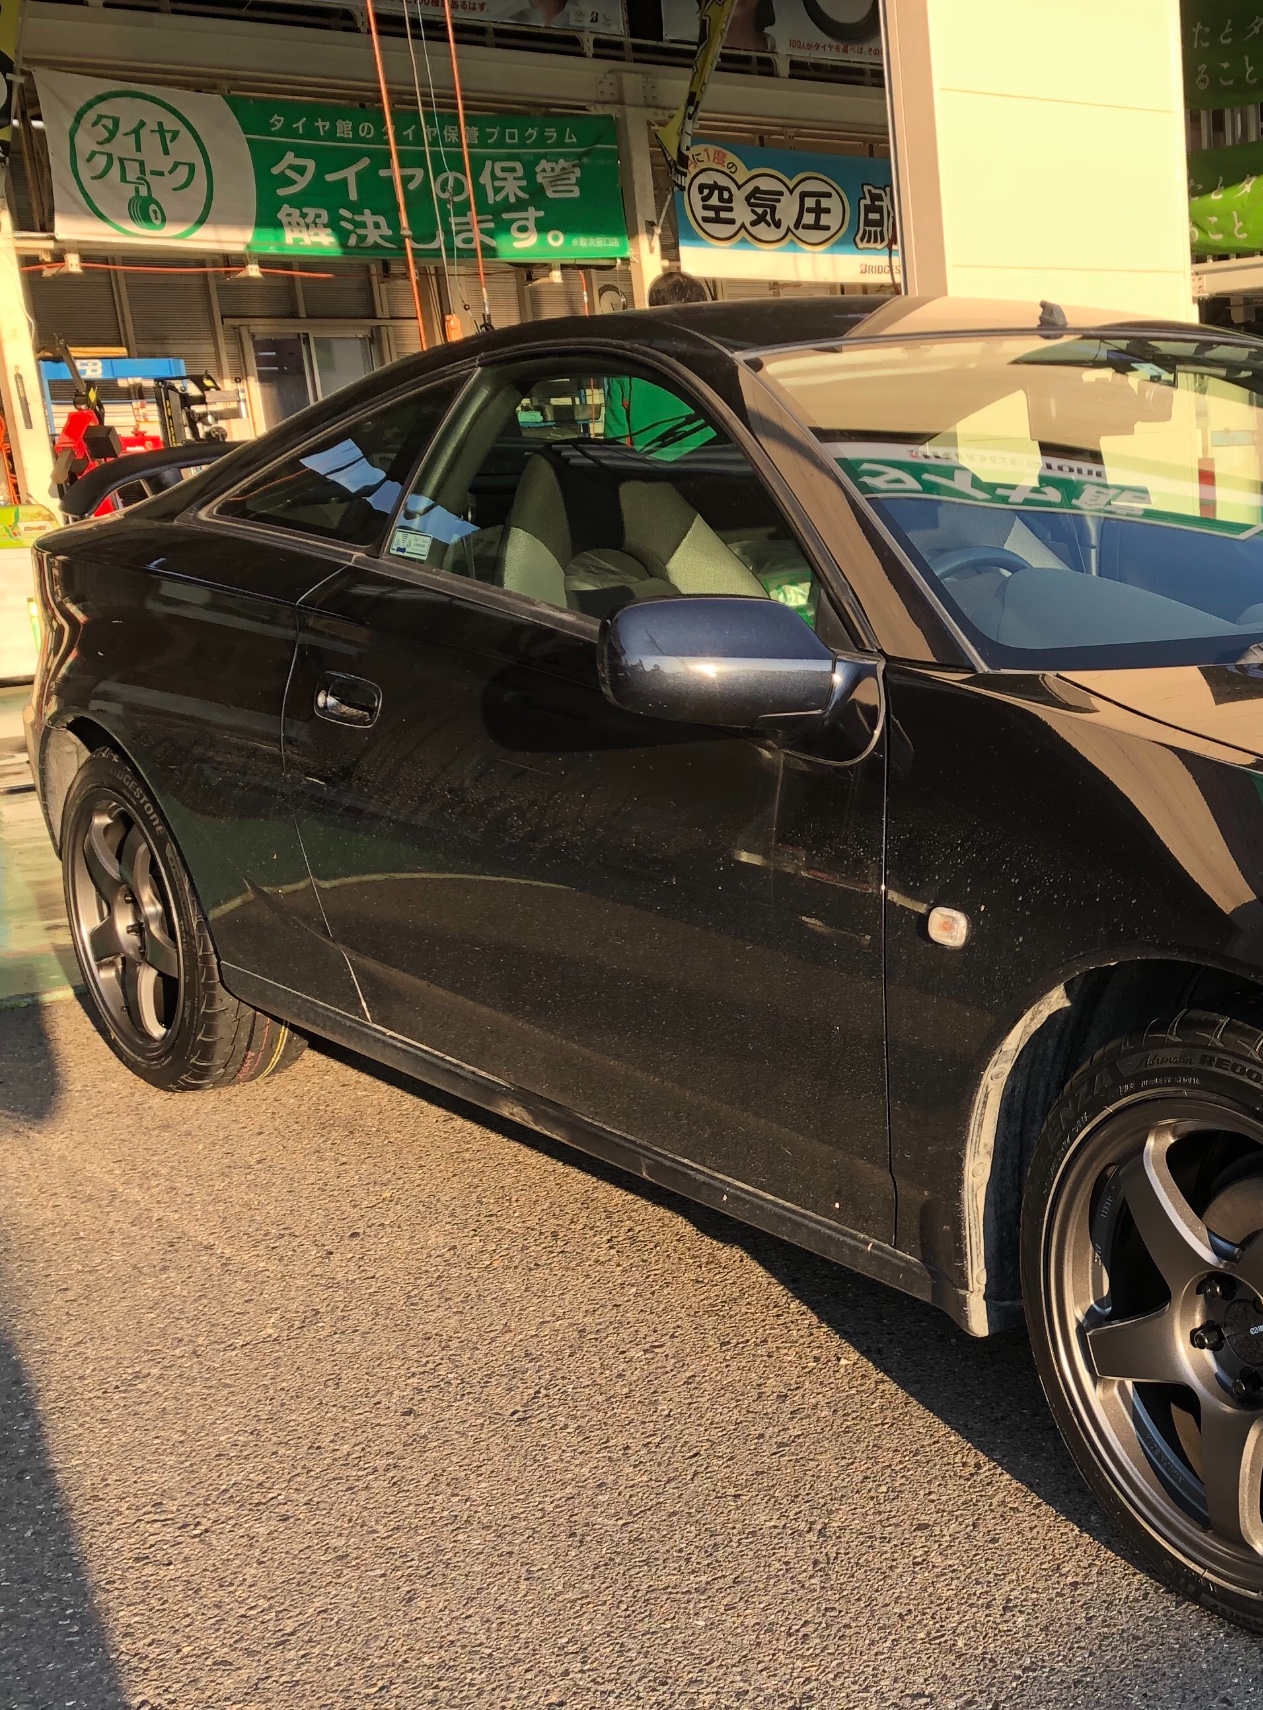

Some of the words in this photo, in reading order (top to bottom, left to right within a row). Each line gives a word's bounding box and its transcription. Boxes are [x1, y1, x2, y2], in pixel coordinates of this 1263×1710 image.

[788, 38, 882, 57] 100人がタイヤを選べば、その
[1195, 54, 1258, 90] ること
[91, 113, 180, 156] タイヤ
[268, 112, 578, 145] タイヤ館のタイヤ保管プログラム
[86, 150, 196, 192] クローク
[271, 150, 582, 203] タイヤの保管
[277, 203, 564, 249] 解決します。
[697, 180, 833, 231] 空気圧
